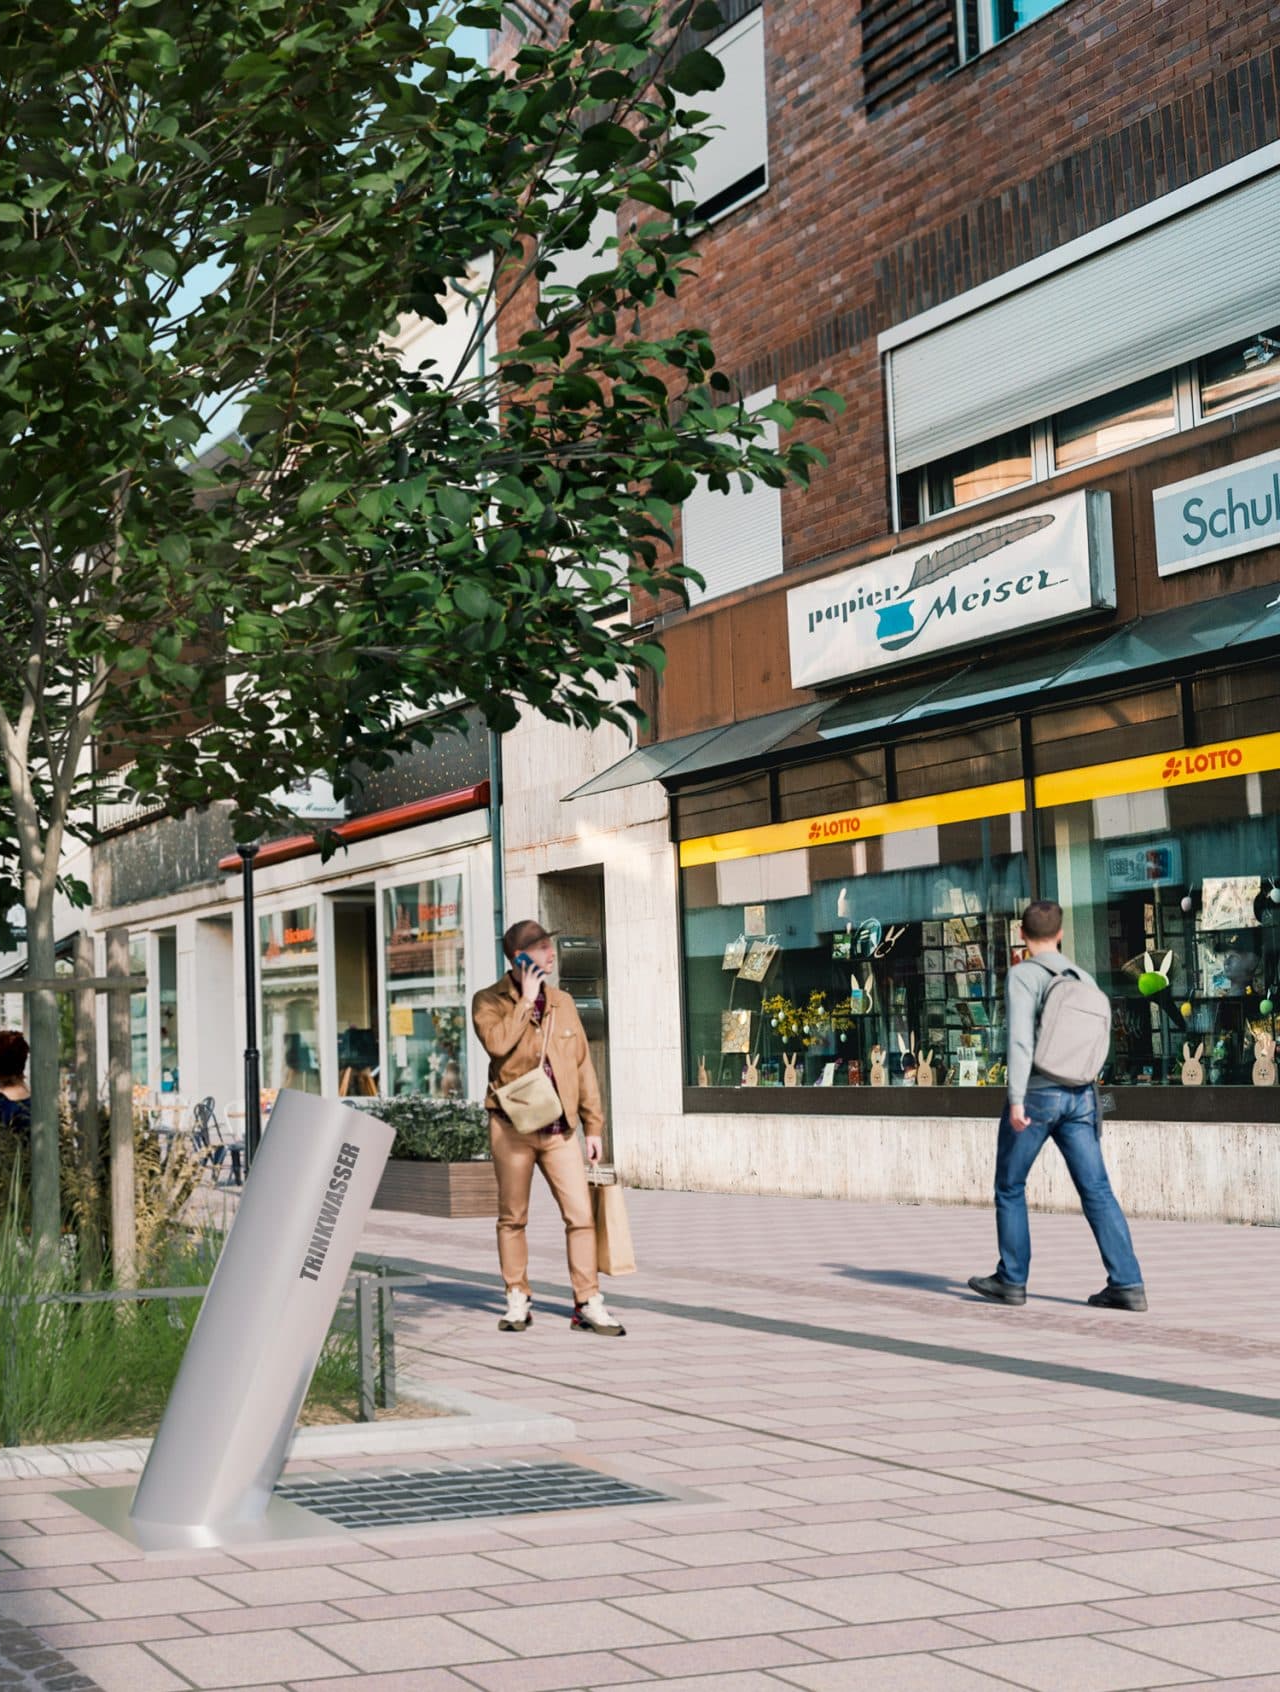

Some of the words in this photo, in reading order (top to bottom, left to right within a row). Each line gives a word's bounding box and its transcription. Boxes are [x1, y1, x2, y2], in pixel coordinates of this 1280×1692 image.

[1182, 473, 1280, 546] Schul
[807, 586, 899, 633] papier
[924, 570, 1069, 621] Meiser
[1185, 748, 1242, 775] LOTTO
[823, 817, 860, 836] LOTTO
[299, 1142, 361, 1281] TRINKWASSER
